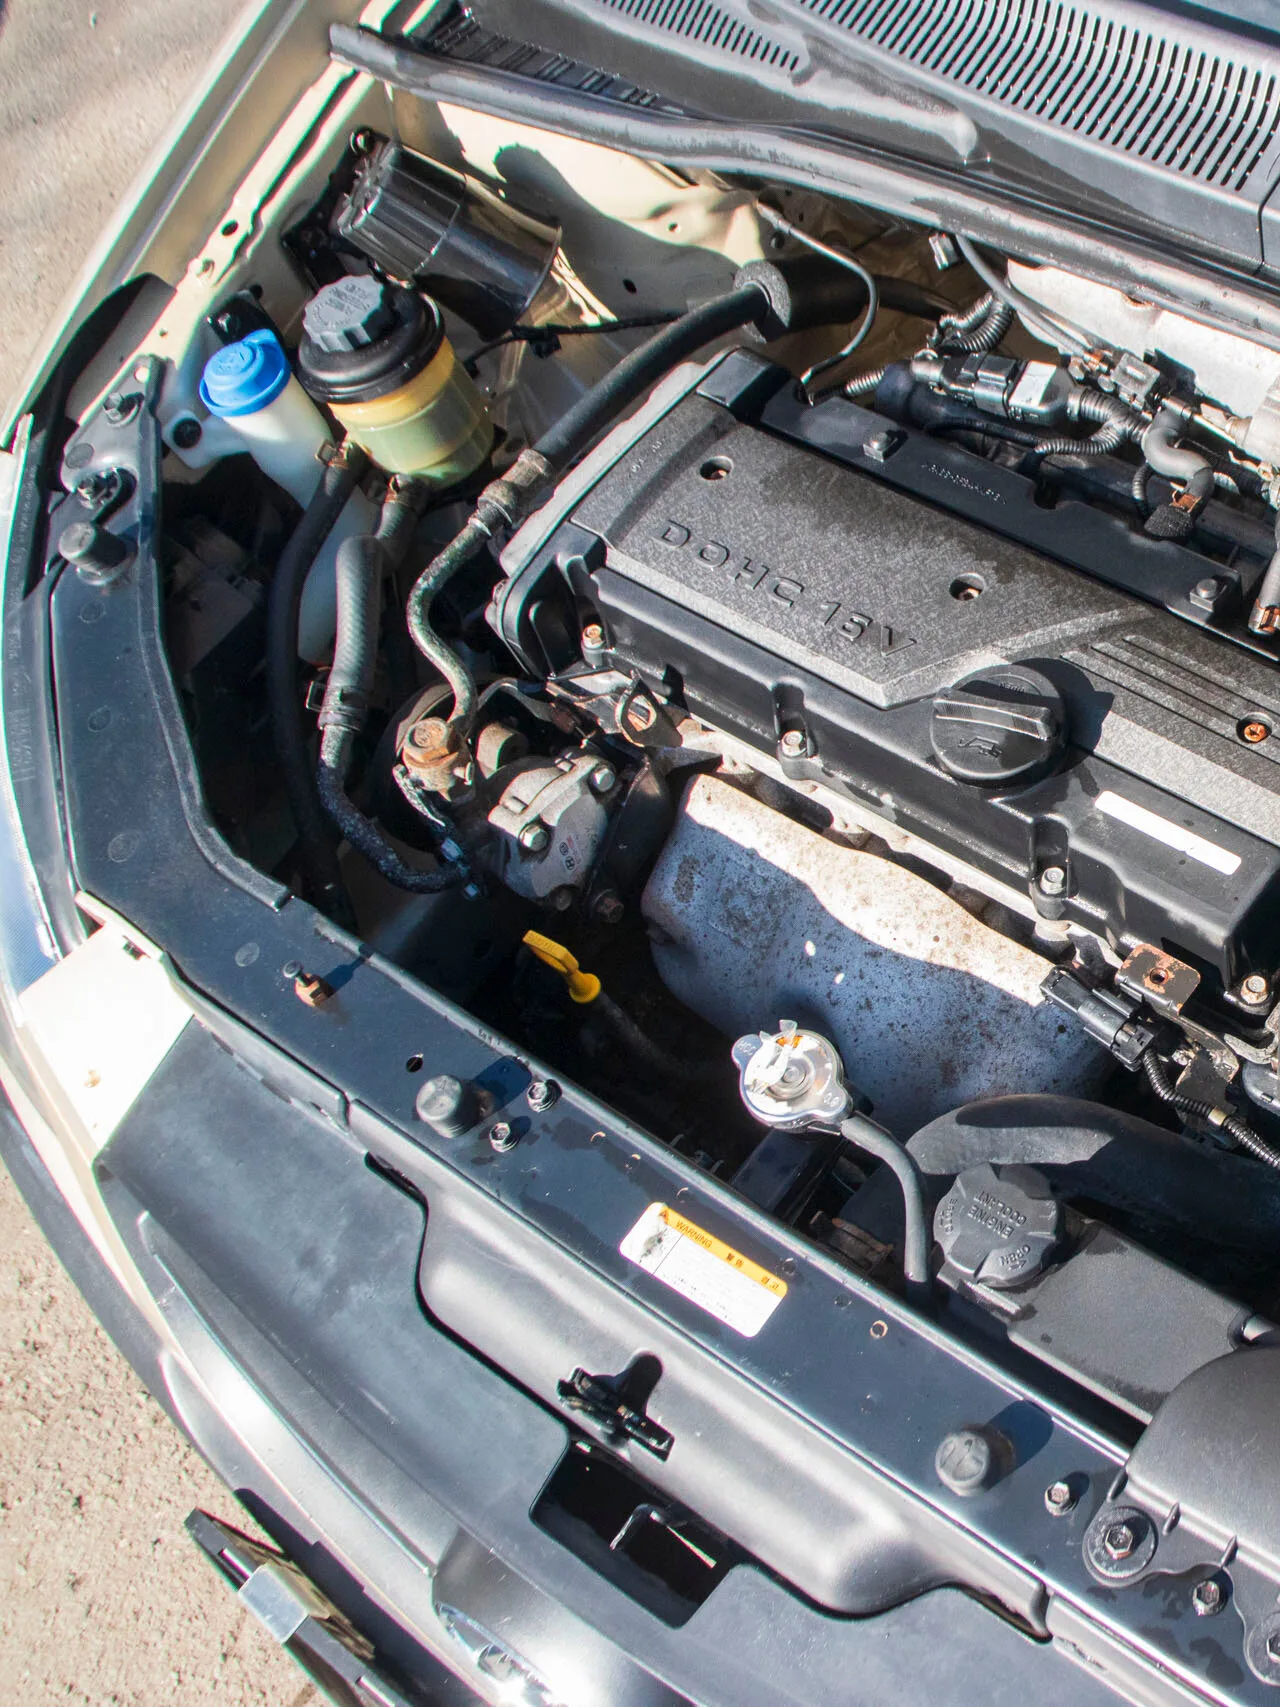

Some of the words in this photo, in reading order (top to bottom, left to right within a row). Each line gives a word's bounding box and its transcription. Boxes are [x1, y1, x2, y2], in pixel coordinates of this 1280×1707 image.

[655, 519, 805, 608] DOHC
[821, 600, 917, 657] 16V
[967, 1204, 1016, 1240] ENGINE
[973, 1190, 1027, 1226] COOLANT
[675, 1220, 713, 1248] WARNING
